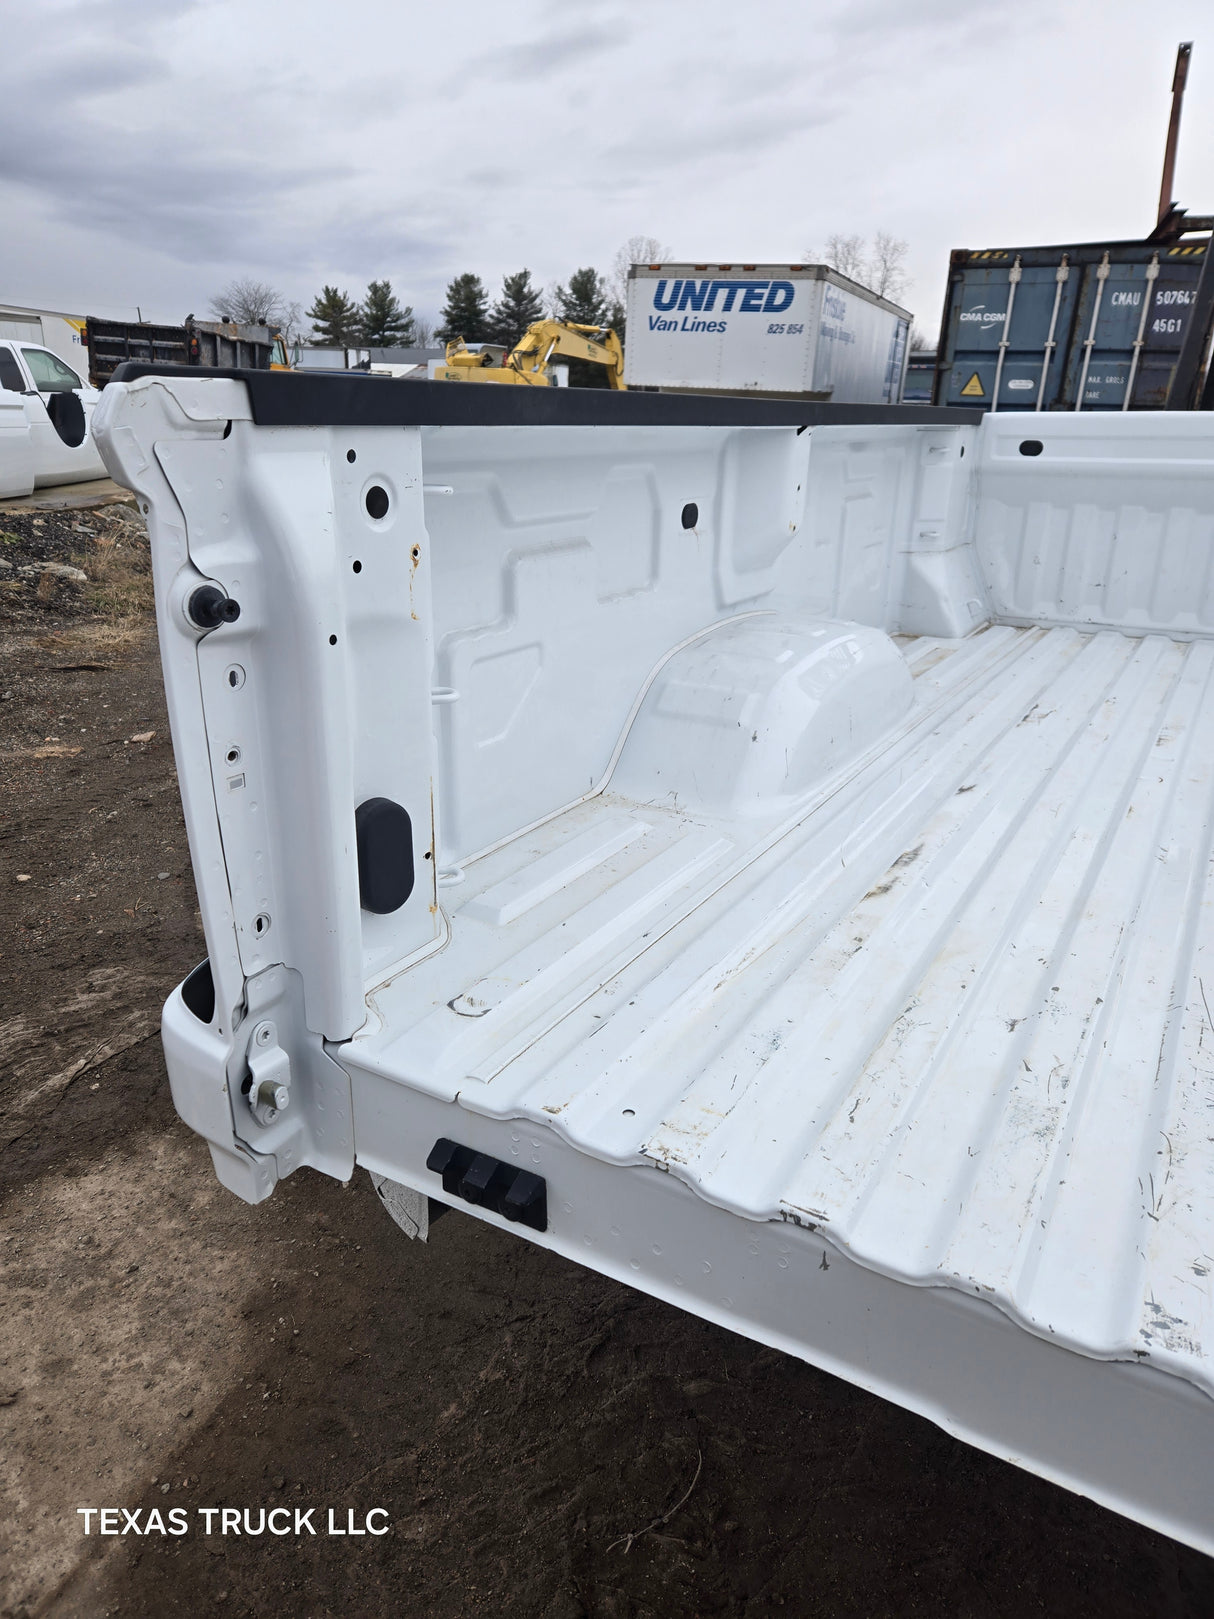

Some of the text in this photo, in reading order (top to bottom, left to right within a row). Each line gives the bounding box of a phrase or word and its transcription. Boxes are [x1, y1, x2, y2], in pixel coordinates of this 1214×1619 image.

[653, 280, 795, 312] UNITED
[1111, 292, 1141, 305] CMAU
[960, 313, 1006, 321] CMA CGM
[648, 316, 727, 333] Van Lines
[767, 323, 804, 335] 825 854
[1152, 319, 1182, 332] 45G1
